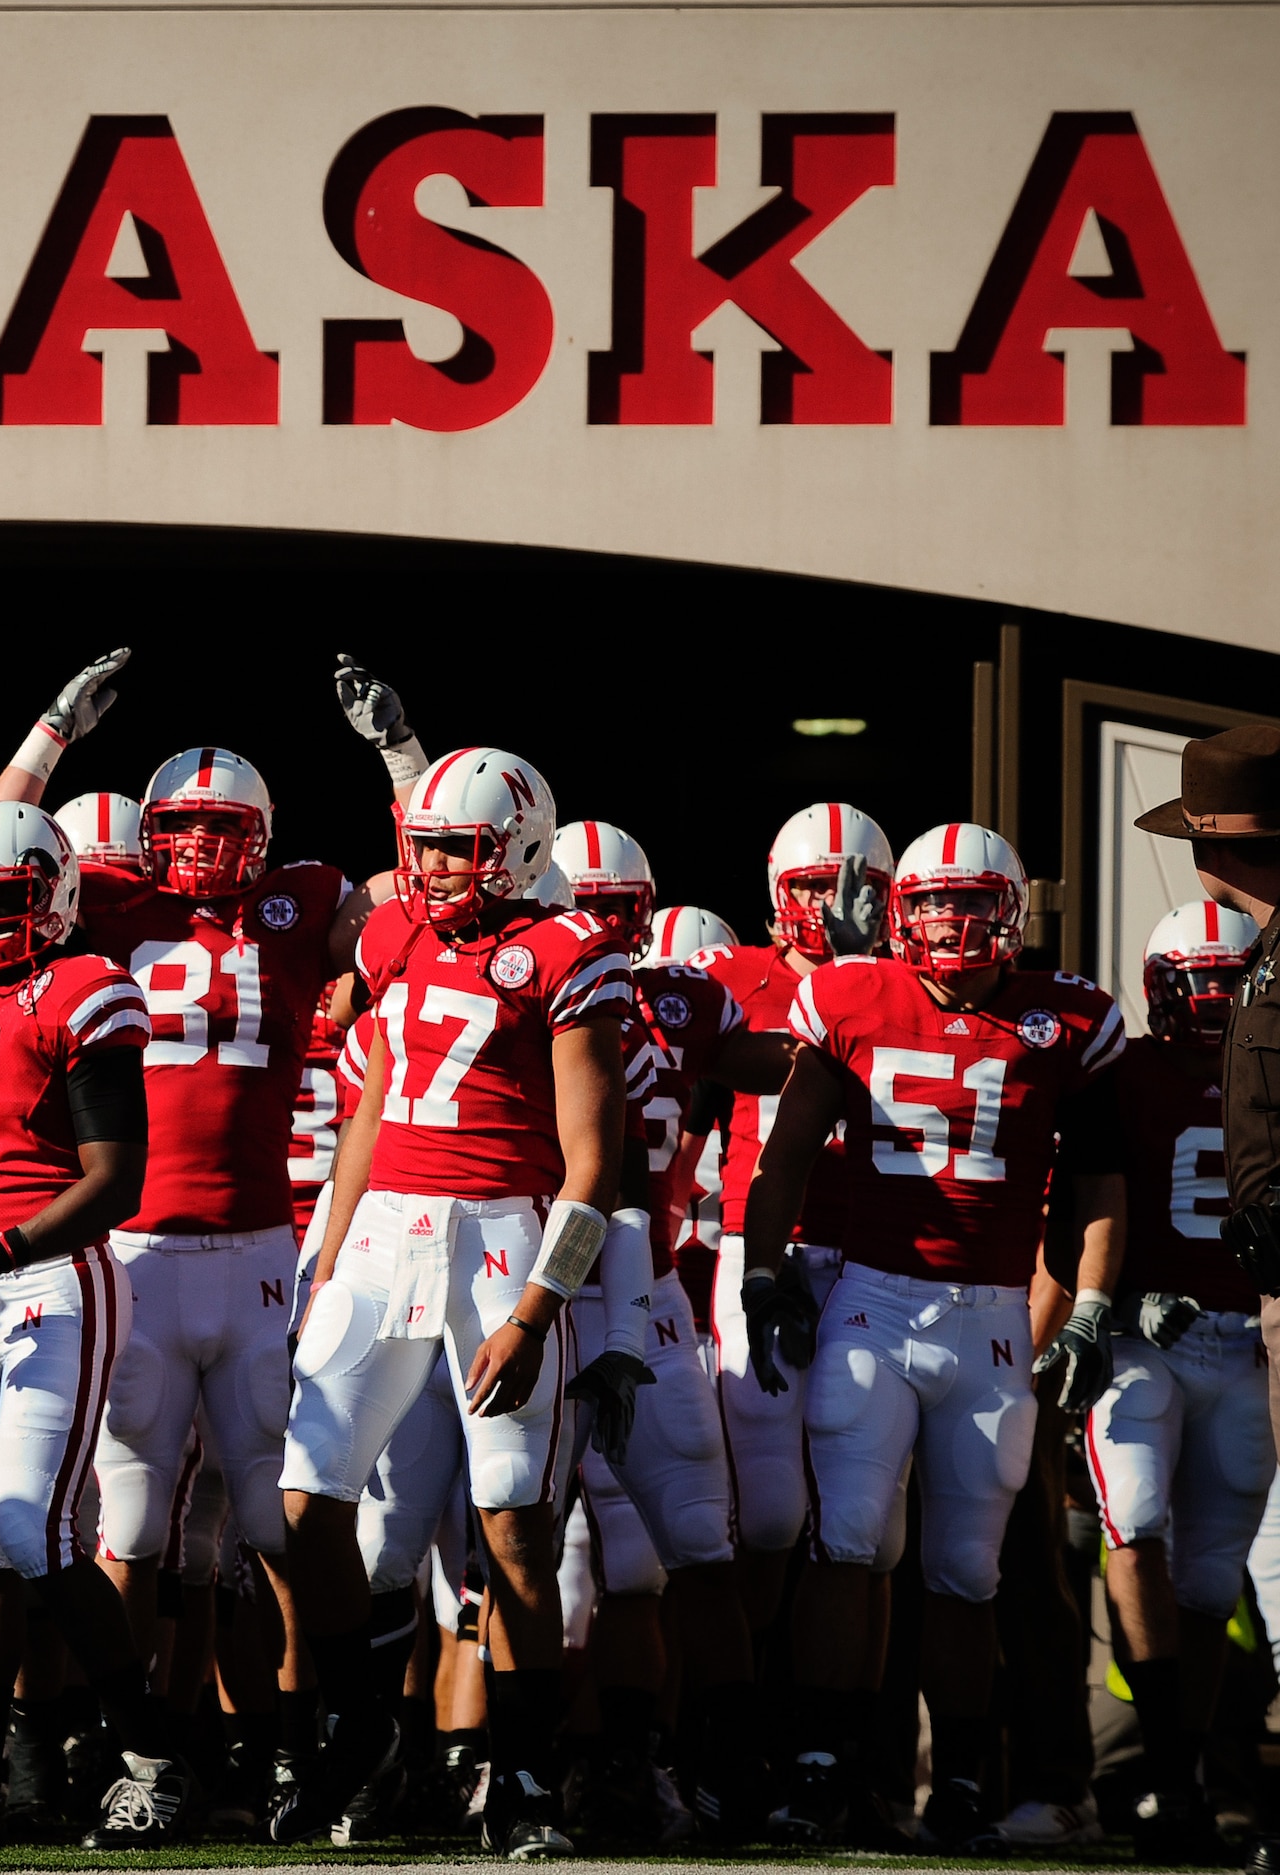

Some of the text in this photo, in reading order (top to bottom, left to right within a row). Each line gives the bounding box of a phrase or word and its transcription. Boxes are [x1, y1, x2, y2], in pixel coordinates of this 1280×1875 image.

[501, 768, 536, 812] N
[129, 940, 270, 1068] 81
[376, 981, 499, 1129] 17
[870, 1046, 1008, 1181] 51
[408, 1228, 435, 1237] adidas
[484, 1249, 510, 1279] N
[260, 1278, 285, 1308] N
[22, 1302, 43, 1331] N
[407, 1305, 425, 1324] 17
[654, 1318, 679, 1347] N
[990, 1339, 1014, 1367] N
